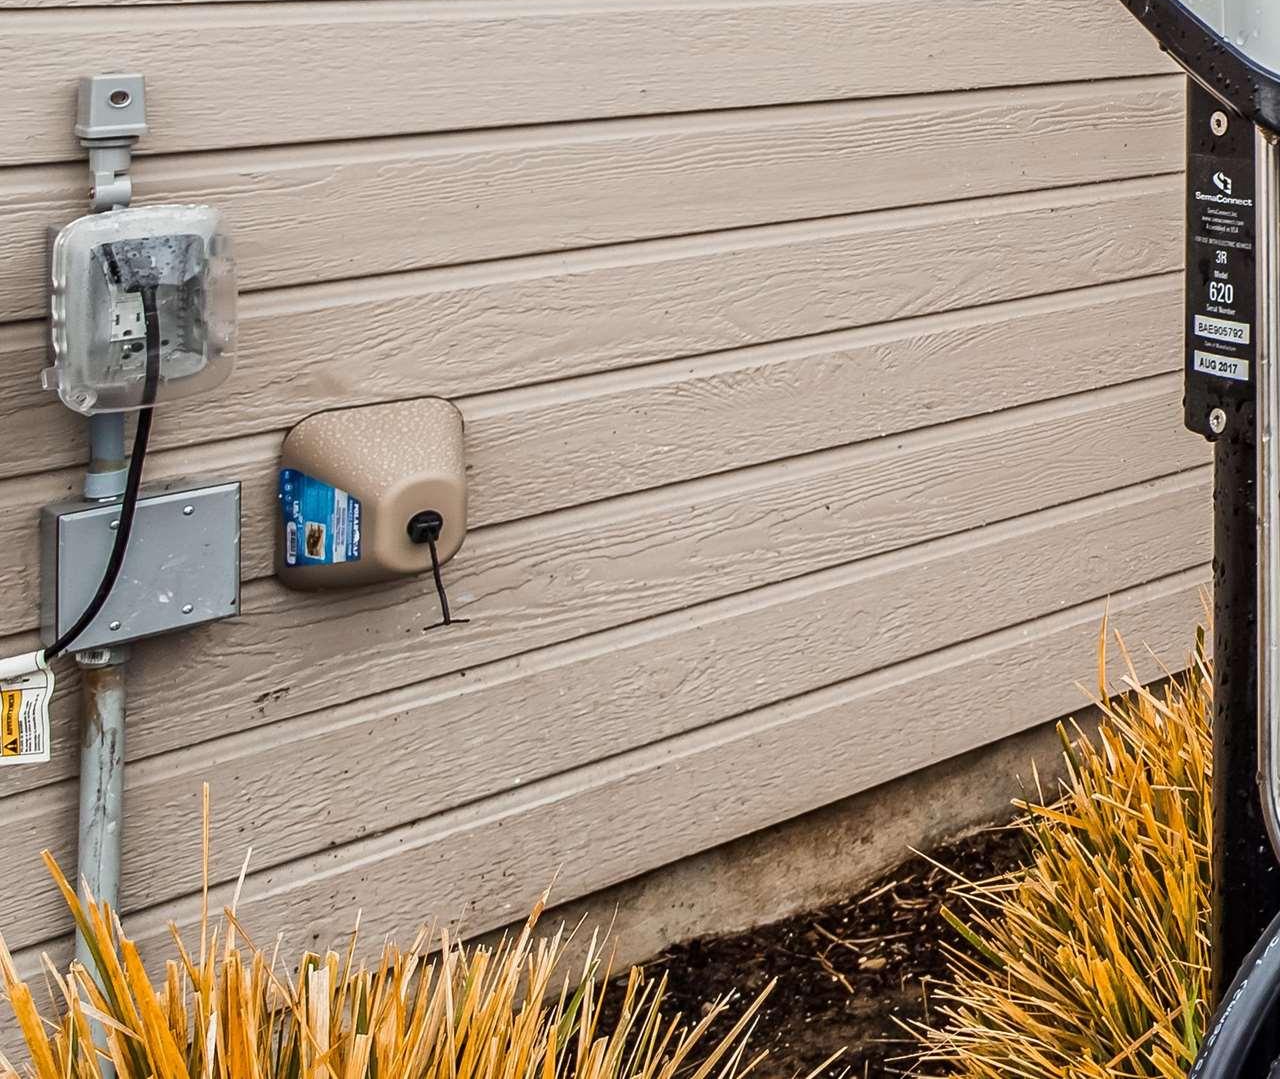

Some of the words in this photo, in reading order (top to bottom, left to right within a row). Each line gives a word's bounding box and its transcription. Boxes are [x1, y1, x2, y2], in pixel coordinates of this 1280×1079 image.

[1195, 191, 1253, 207] SemaConnect
[1215, 250, 1228, 265] 3R
[1214, 270, 1229, 280] Model
[1209, 281, 1234, 304] 620
[1199, 357, 1217, 371] AUG
[1218, 360, 1238, 375] 2017
